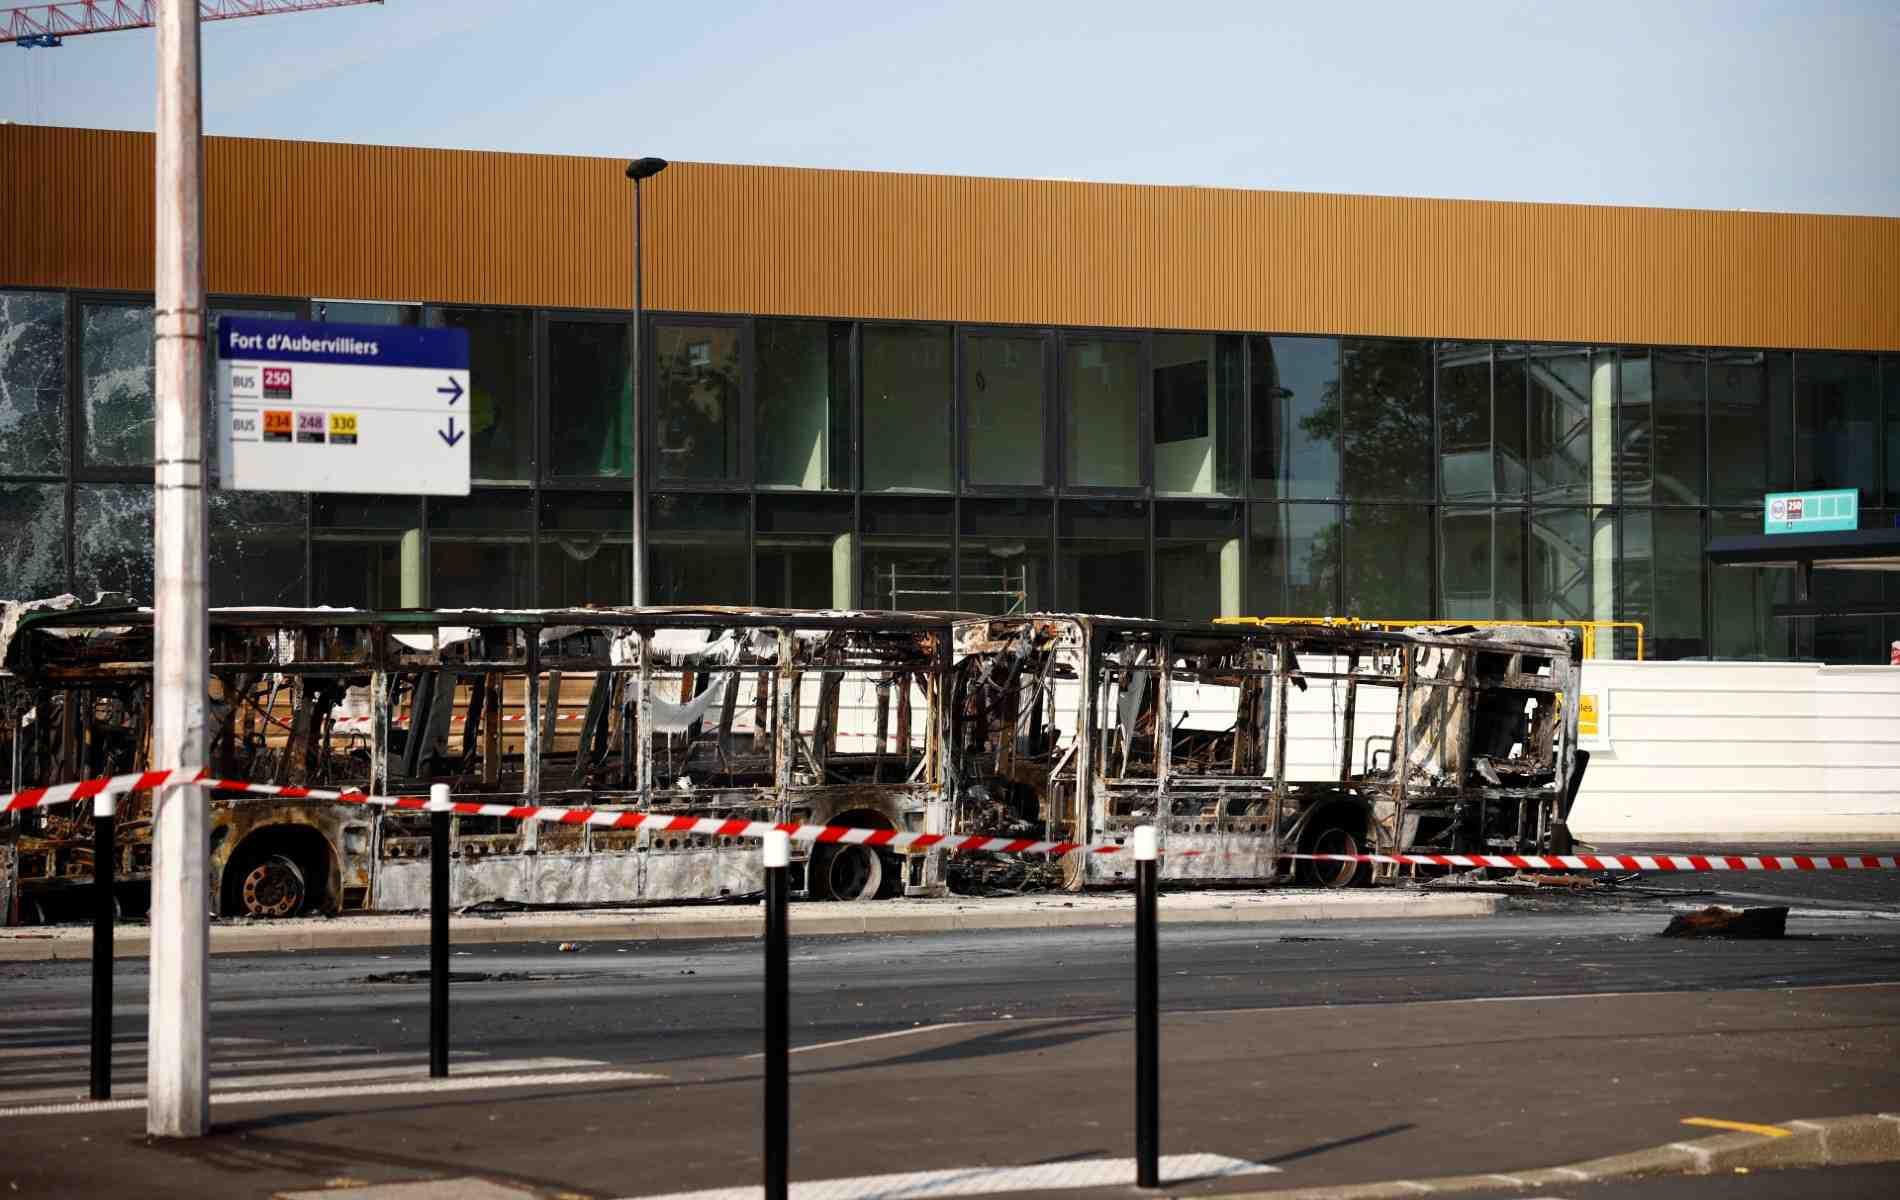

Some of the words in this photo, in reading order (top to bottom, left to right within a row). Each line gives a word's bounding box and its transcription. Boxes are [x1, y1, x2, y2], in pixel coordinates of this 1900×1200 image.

[230, 333, 263, 350] Fort
[266, 334, 379, 355] d'Aubervilliers
[233, 376, 255, 388] BUS
[265, 372, 290, 386] 250
[233, 418, 255, 431] BUS
[300, 416, 323, 429] 248
[332, 416, 356, 430] 330
